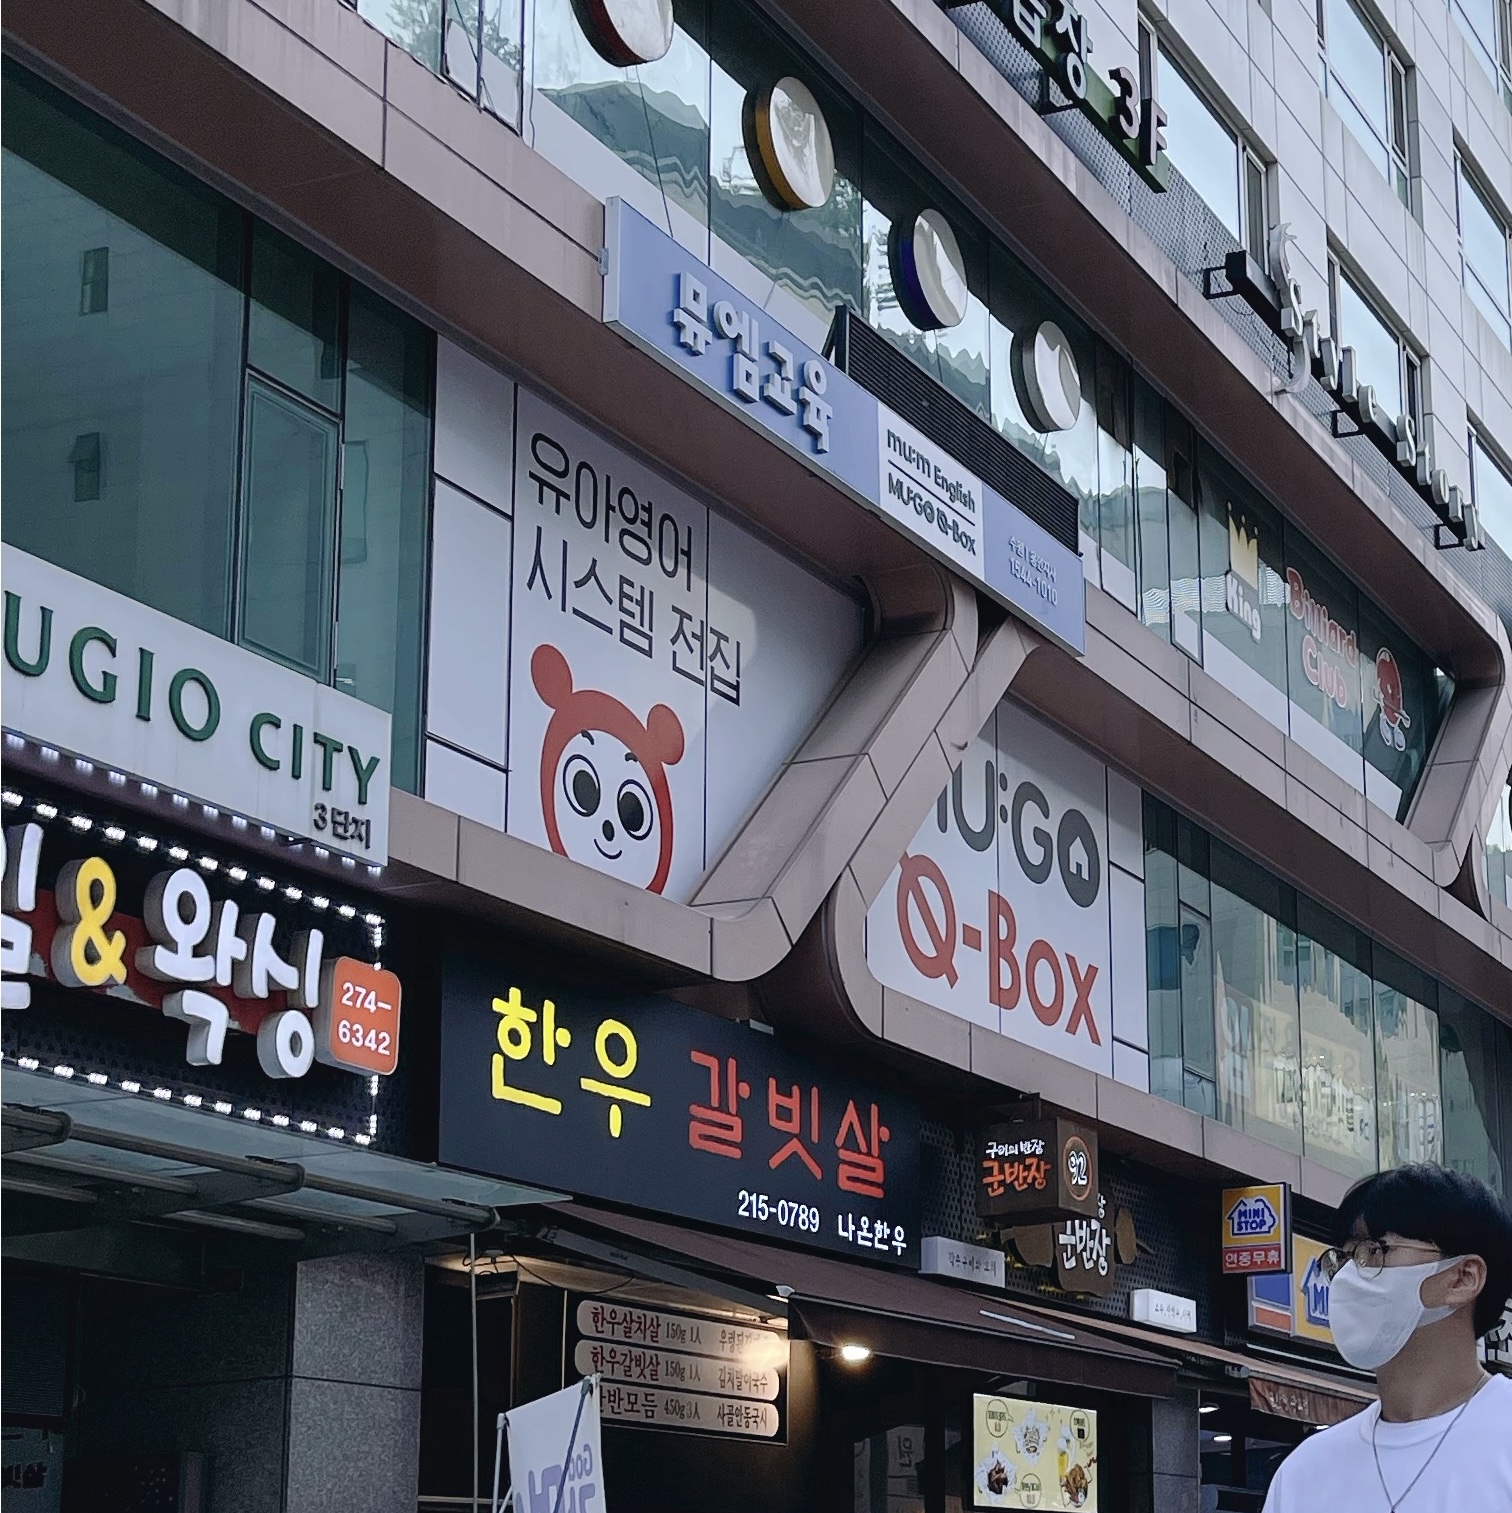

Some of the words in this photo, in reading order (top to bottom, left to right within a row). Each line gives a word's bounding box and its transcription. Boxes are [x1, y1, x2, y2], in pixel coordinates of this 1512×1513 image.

[1108, 66, 1168, 165] 3F
[672, 270, 834, 455] 뮤엠교육
[527, 432, 694, 592] 유아영어
[933, 463, 976, 514] English
[1009, 556, 1058, 606] 1544-1010
[1226, 572, 1262, 643] King
[526, 524, 655, 660] 시스템
[669, 602, 741, 708] 전집
[1286, 567, 1359, 668] Billiard
[1303, 634, 1347, 709] Club
[249, 712, 381, 805] CITY
[140, 867, 324, 1079] 왁싱
[337, 1018, 391, 1057] 6342
[490, 986, 652, 1139] 한우
[688, 1049, 892, 1199] 갈빗살
[1020, 1138, 1046, 1156] 반장
[981, 1156, 1053, 1198] 군반장
[737, 1189, 821, 1234] 215-0789
[837, 1212, 908, 1257] 나온한우
[1236, 1219, 1267, 1232] STOP
[1237, 1207, 1266, 1221] MINI
[1224, 1250, 1280, 1267] 연중무휴
[590, 1304, 662, 1346] 한우살치살
[665, 1321, 687, 1345] 150g
[590, 1344, 661, 1383] 한우갈빗살
[664, 1360, 686, 1383] 150g
[663, 1399, 686, 1420] 450g
